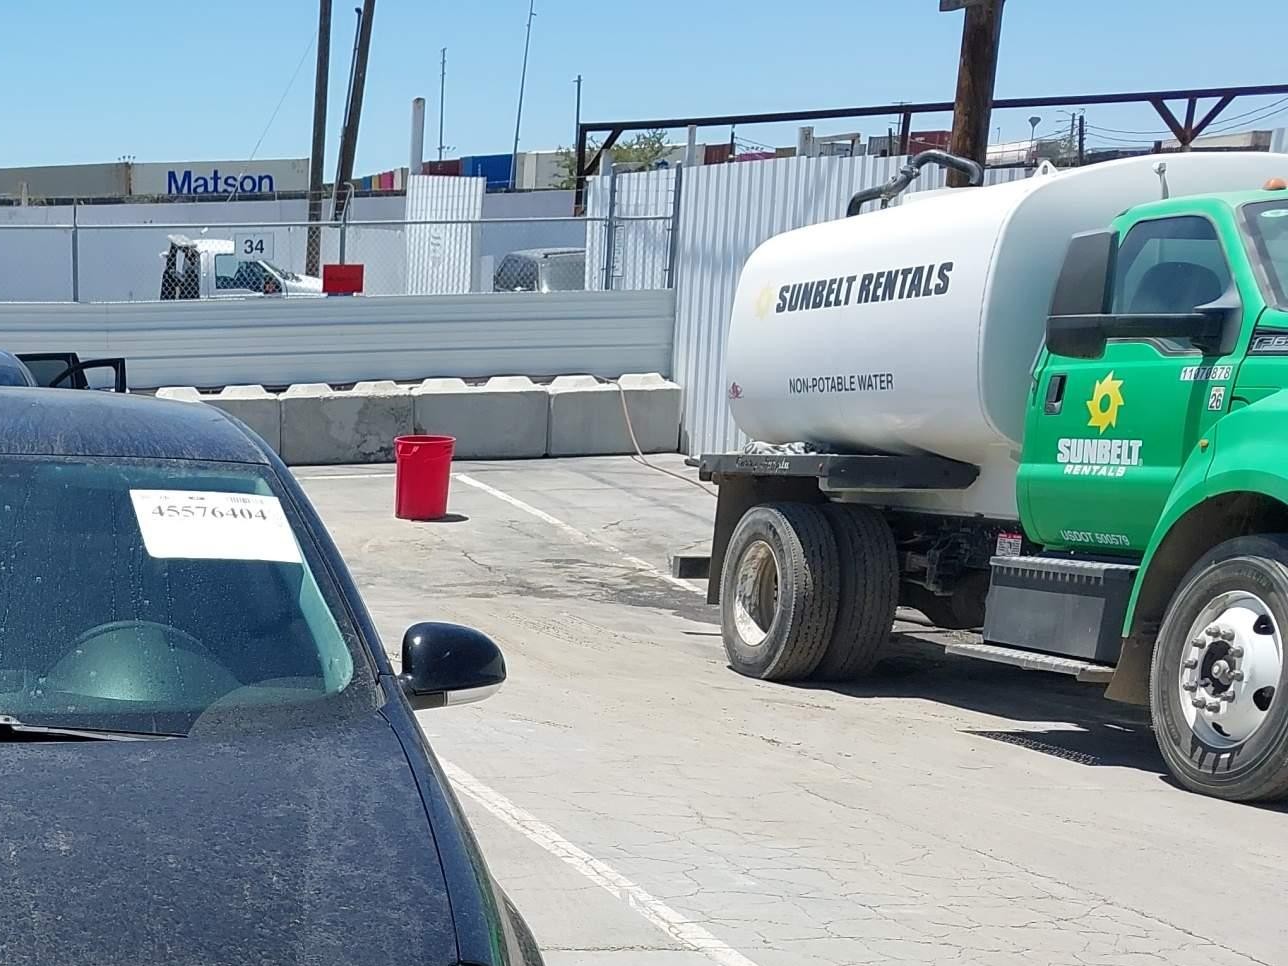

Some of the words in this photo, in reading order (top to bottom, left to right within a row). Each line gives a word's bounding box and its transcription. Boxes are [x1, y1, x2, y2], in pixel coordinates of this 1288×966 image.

[167, 169, 274, 194] Matson
[243, 239, 265, 255] 34
[775, 274, 858, 314] SUNBELT
[856, 261, 954, 305] RENTALS
[788, 374, 856, 394] NON-POTABLE
[857, 372, 894, 391] WATER
[1209, 392, 1223, 409] 26
[1056, 438, 1143, 466] SUNBELT
[1063, 464, 1126, 477] RENTALS
[152, 504, 268, 521] 45576404
[1059, 529, 1094, 543] USDOT
